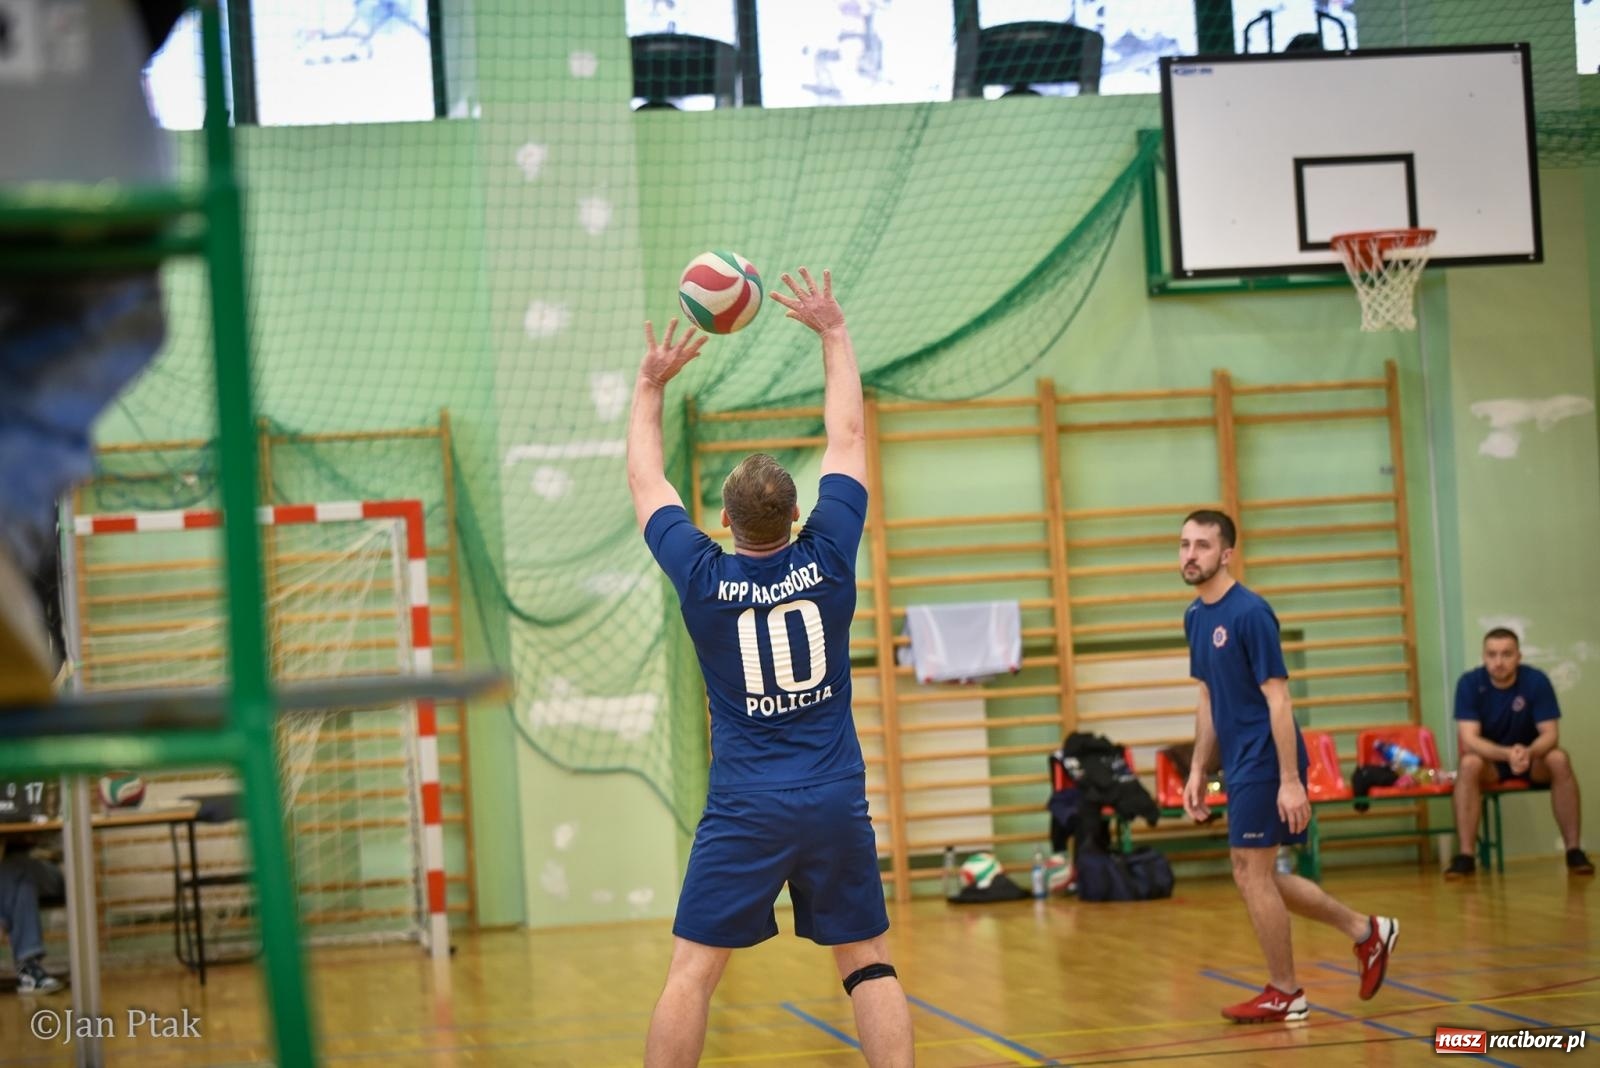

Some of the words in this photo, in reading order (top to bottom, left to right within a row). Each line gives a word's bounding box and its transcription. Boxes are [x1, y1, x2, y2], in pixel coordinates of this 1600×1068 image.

[718, 580, 749, 602] KPP
[752, 562, 824, 605] RACIBÓRZ
[737, 599, 827, 695] 10
[746, 685, 833, 717] POLICJA
[24, 781, 44, 805] 17
